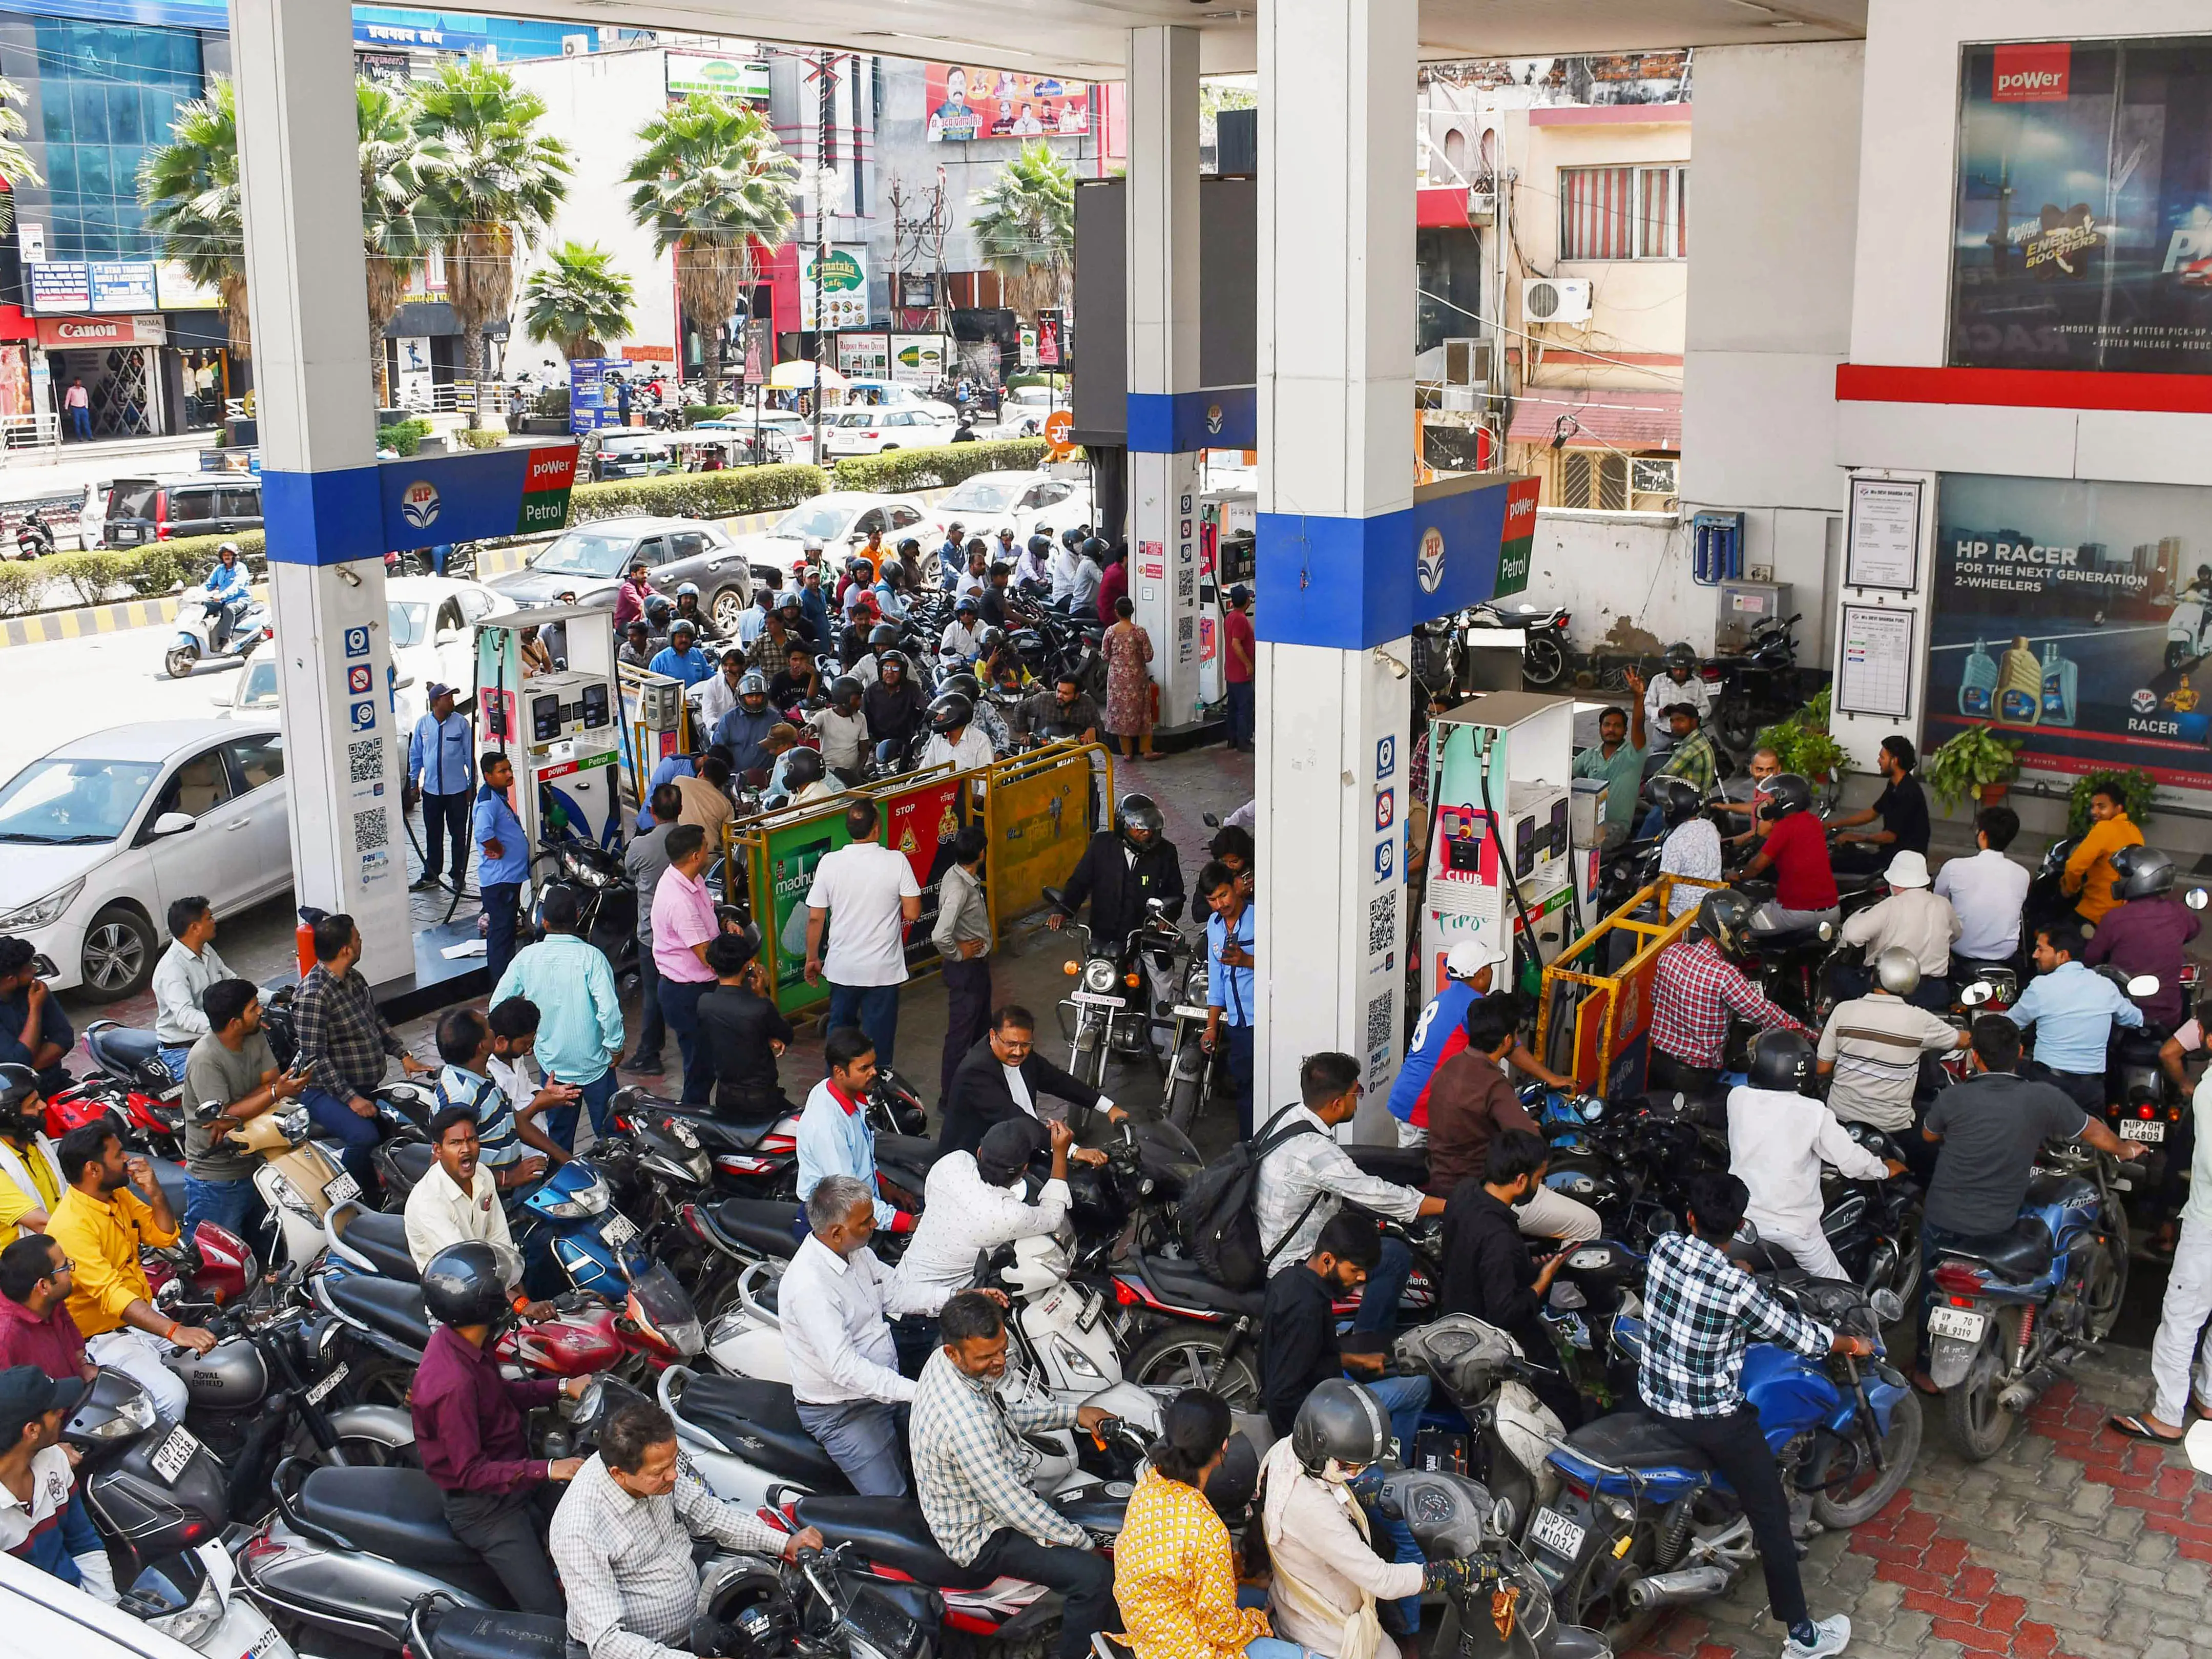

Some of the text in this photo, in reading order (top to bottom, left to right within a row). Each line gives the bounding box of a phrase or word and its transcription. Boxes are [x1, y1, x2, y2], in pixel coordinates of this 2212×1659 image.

[2026, 233, 2097, 268] BOOSTERS
[811, 259, 854, 276] krnataka
[58, 323, 117, 339] Canon
[137, 319, 160, 327] PIXMA
[2060, 325, 2206, 336] SMOOTH DRIVE BETTER PICK-UP
[2133, 340, 2171, 349] MILEAGE
[411, 486, 432, 503] HP
[526, 501, 562, 522] Petrol
[1425, 535, 1441, 558] HP
[1955, 540, 2077, 566] HP RACER
[1501, 553, 1527, 580] Petrol
[1955, 562, 2148, 587] FOR THE NEXT GENERATION
[1954, 576, 2042, 592] 2-WHEELERS
[2138, 692, 2152, 700] HP
[2128, 717, 2179, 735] RACER
[589, 754, 609, 766] Petrol
[895, 803, 915, 817] STOP
[776, 857, 816, 895] madhu
[1446, 869, 1483, 885] CLUB
[1550, 894, 1566, 909] Petrol
[1411, 1000, 1439, 1053] 8
[2128, 1121, 2160, 1131] UP70H
[2128, 1131, 2159, 1141] C4809
[1942, 1313, 1973, 1326] UP 70
[1952, 1325, 1971, 1337] 9319
[194, 1370, 220, 1379] ROYAL
[192, 1379, 223, 1388] ENFIELD
[158, 1430, 185, 1463] UP70D
[169, 1440, 195, 1474] H1538
[1545, 1511, 1579, 1541] UP70C
[1539, 1526, 1573, 1555] M1034
[261, 1627, 278, 1646] 2172
